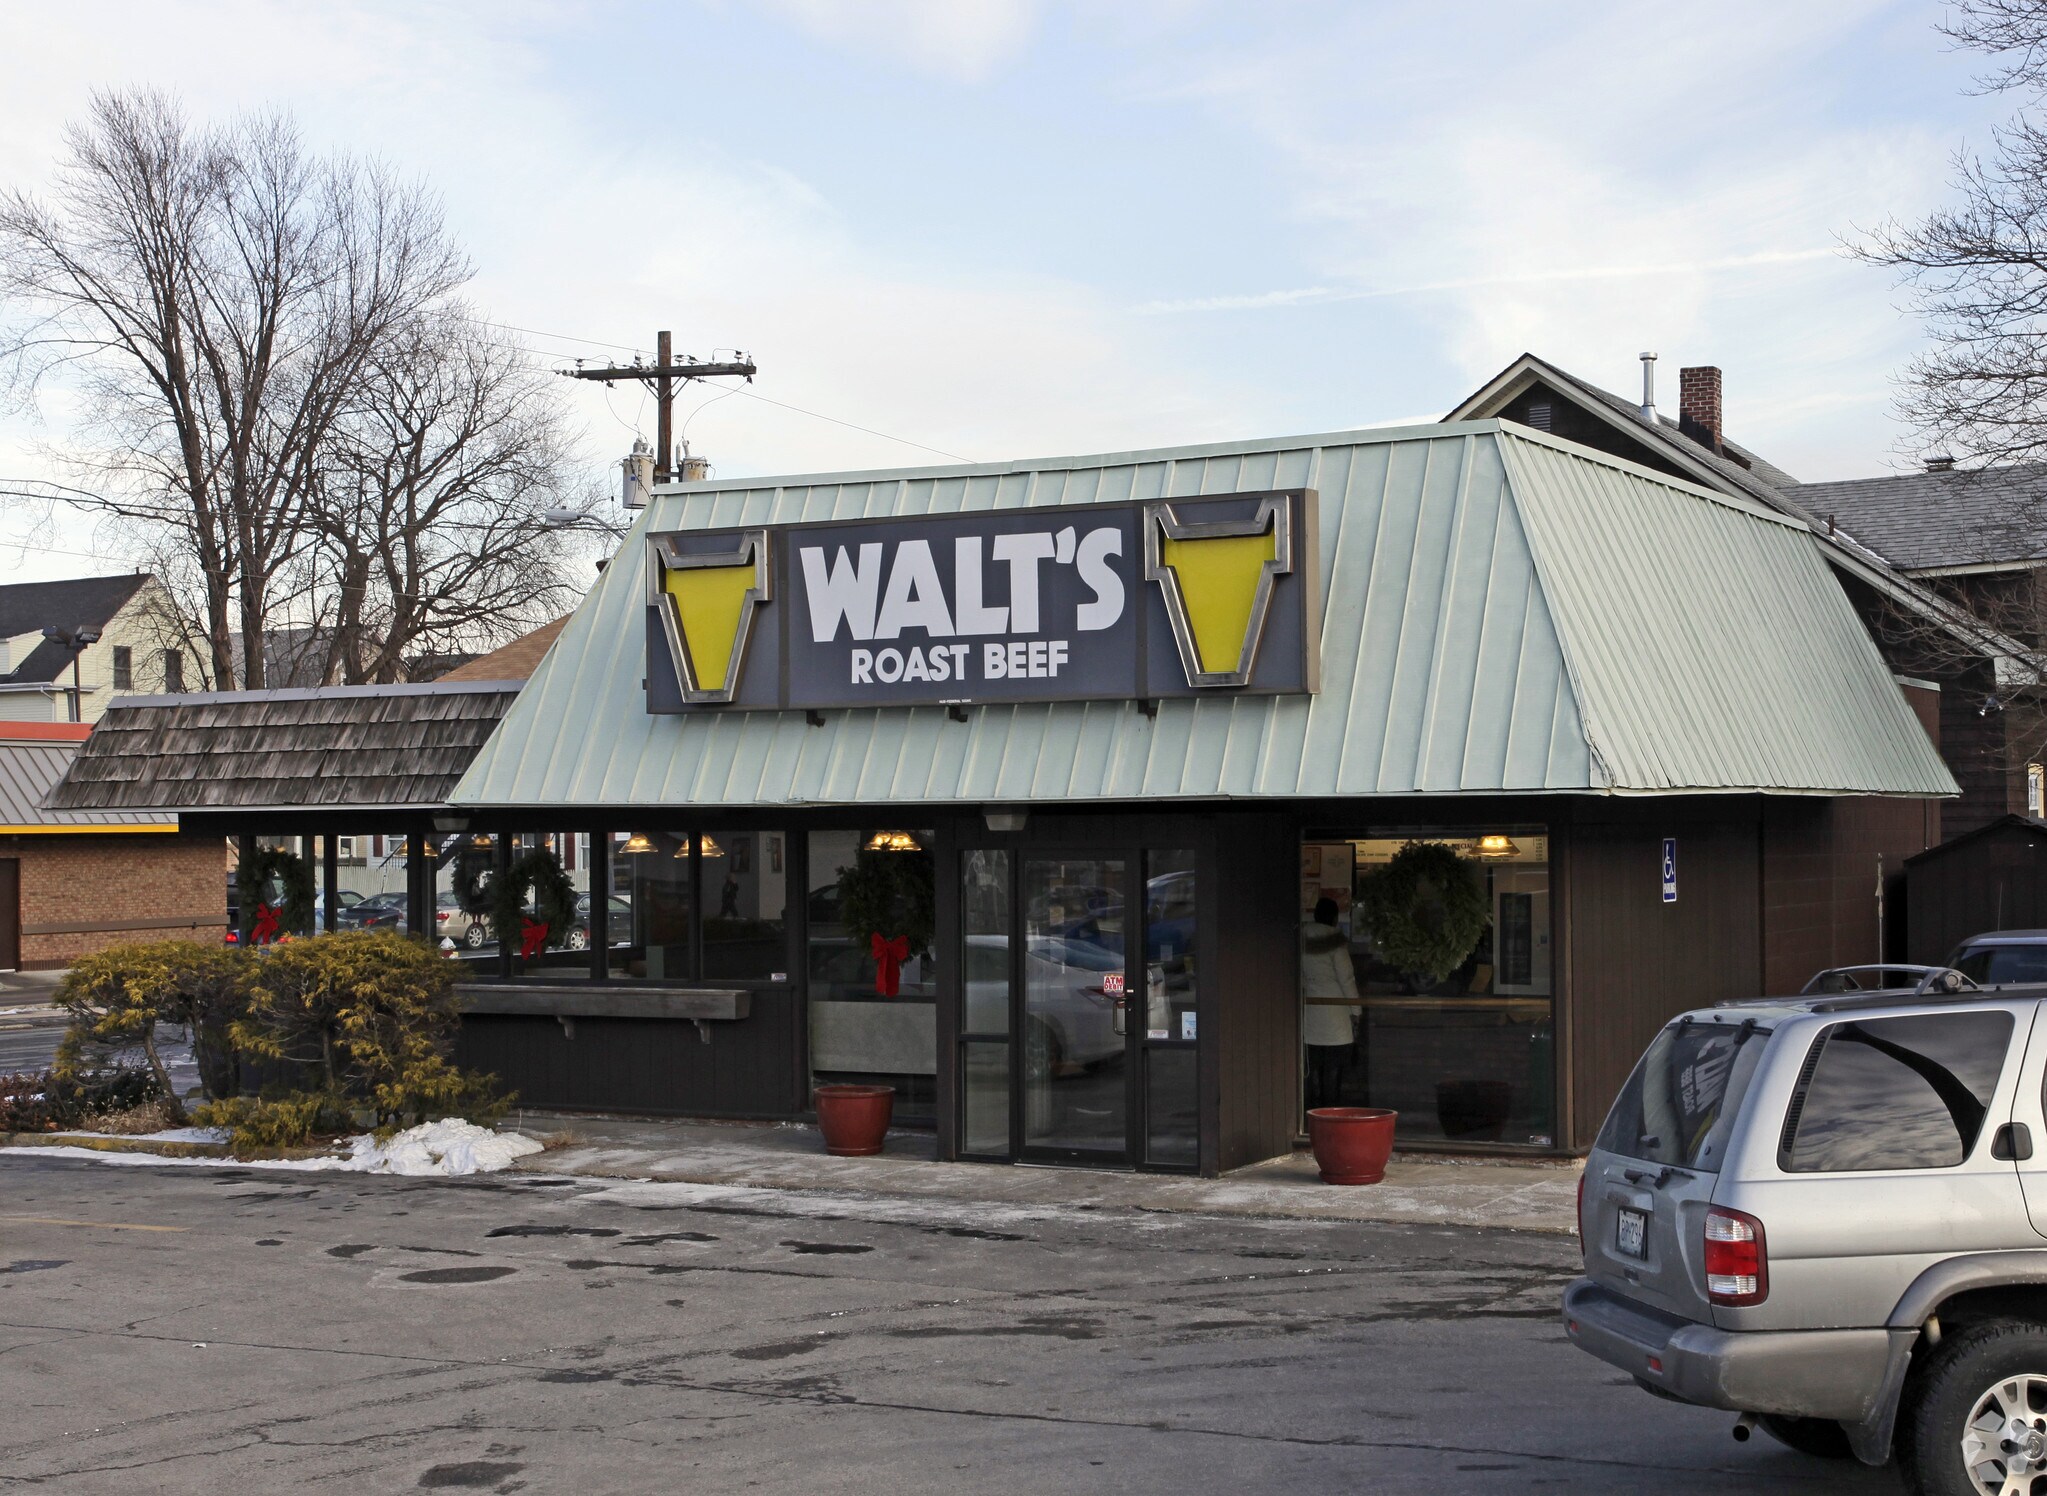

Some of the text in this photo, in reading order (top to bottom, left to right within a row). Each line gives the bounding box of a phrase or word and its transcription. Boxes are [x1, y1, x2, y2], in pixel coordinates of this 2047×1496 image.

[799, 526, 1125, 642] WALT'S
[851, 640, 1069, 684] ROAST BEEF
[1104, 976, 1123, 985] ATM
